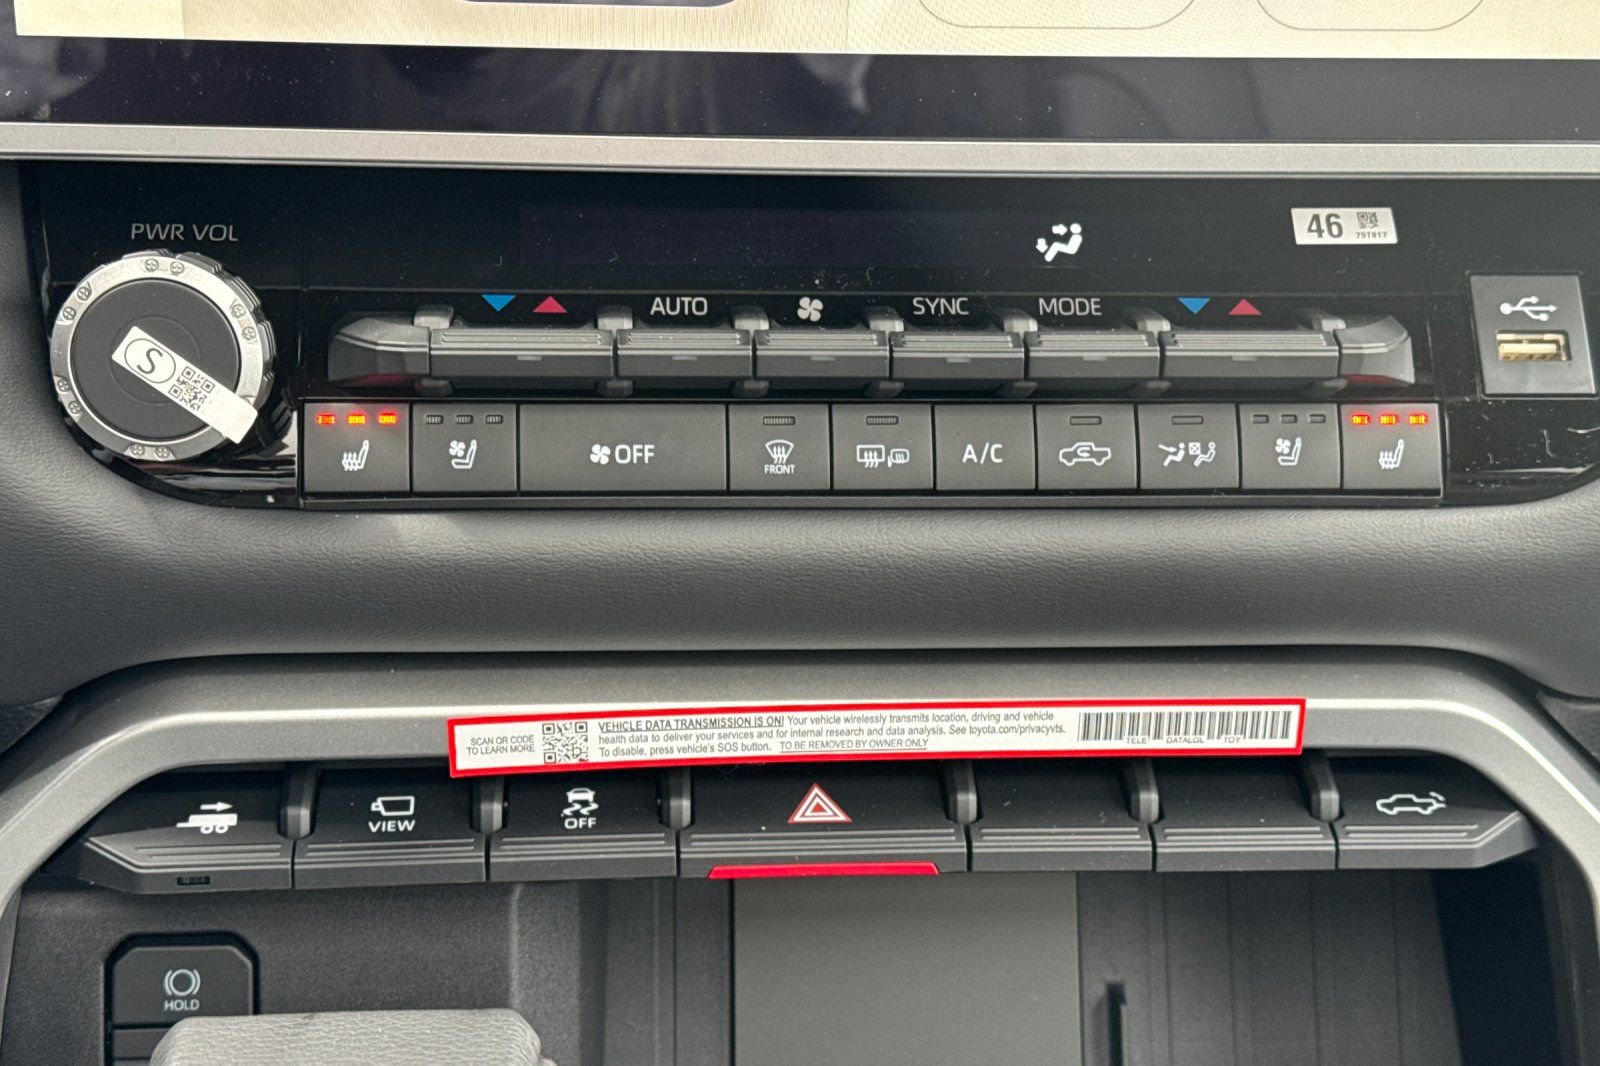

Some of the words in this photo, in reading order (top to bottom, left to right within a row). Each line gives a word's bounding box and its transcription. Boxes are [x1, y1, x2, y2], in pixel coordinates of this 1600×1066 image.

[131, 222, 184, 241] PWR
[193, 223, 239, 242] VOL
[1307, 213, 1343, 238] 46
[650, 297, 708, 317] AUTO
[912, 297, 970, 317] SYNC
[1038, 297, 1103, 317] MODE
[136, 347, 163, 375] S
[614, 444, 656, 464] OFF
[962, 443, 1003, 464] A/C
[764, 463, 795, 475] FRONT
[598, 720, 642, 733] VEHICLE
[645, 719, 672, 731] DATA
[675, 716, 751, 730] TRANSMISSION
[754, 716, 764, 727] IS
[787, 714, 808, 726] Your
[810, 714, 841, 724] vehicle
[843, 713, 887, 725] wirelessly
[889, 712, 930, 723] transmits
[932, 712, 969, 723] location,
[971, 711, 1001, 724] driving
[1003, 711, 1021, 721] and
[1023, 710, 1054, 721] vehicle
[470, 736, 494, 746] SCAN
[510, 734, 535, 744] CODE
[598, 734, 626, 745] health
[628, 733, 649, 744] data
[651, 733, 660, 743] to
[663, 732, 694, 743] deliver
[695, 733, 715, 743] your
[717, 729, 754, 741] services
[756, 729, 774, 739] and
[776, 728, 788, 738] for
[790, 727, 823, 738] internal
[825, 727, 864, 737] research
[866, 726, 884, 736] and
[886, 725, 906, 736] data
[907, 725, 946, 737] analysis.
[948, 724, 966, 735] See
[1126, 736, 1148, 745] TELE
[1223, 735, 1241, 743] TOY
[466, 746, 479, 756] TO
[480, 745, 508, 755] LEARN
[510, 744, 535, 753] MORE
[598, 746, 610, 757] To
[612, 745, 648, 757] disable,
[650, 745, 674, 757] press
[676, 742, 715, 754] vehicle's
[717, 742, 739, 752] SOS
[741, 741, 772, 752] button.
[780, 741, 793, 750] TO
[794, 740, 807, 750] BE
[808, 740, 853, 749] REMOVED
[855, 739, 868, 748] BY
[869, 739, 903, 748] OWNER
[904, 738, 929, 747] ONLY
[368, 818, 415, 834] VIEW
[563, 816, 597, 830] OFF
[164, 999, 200, 1012] HOLD
